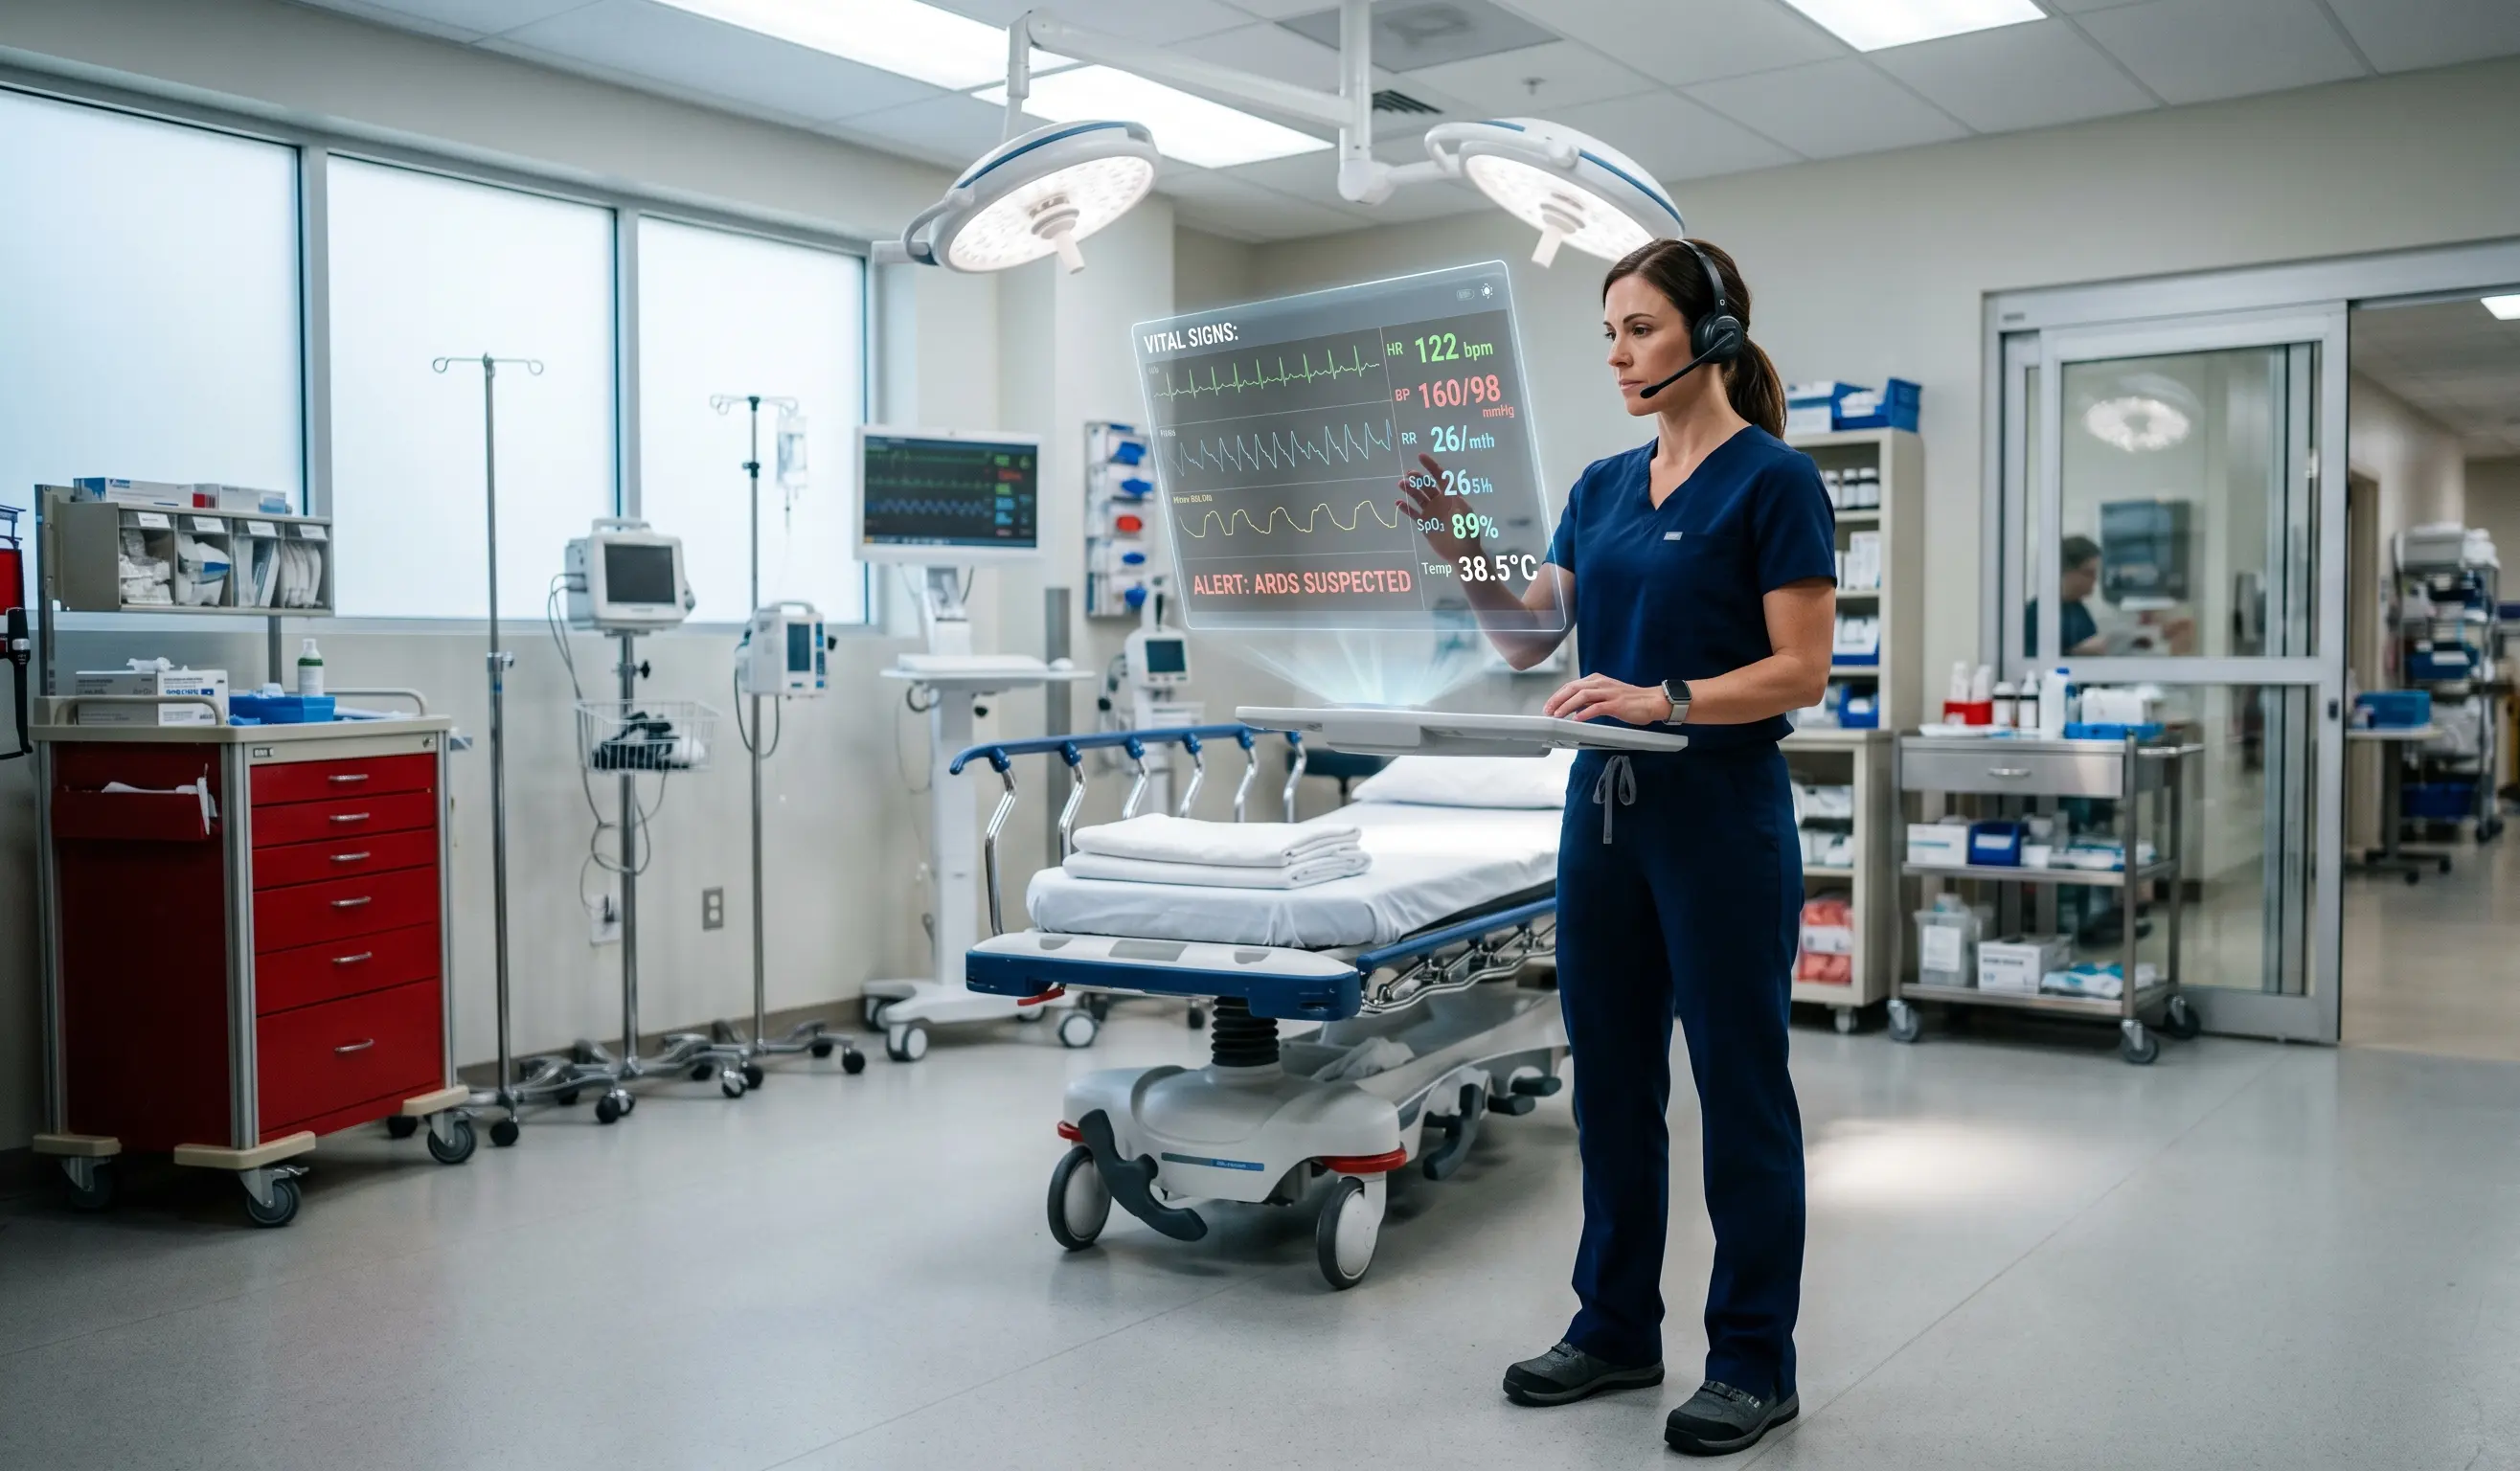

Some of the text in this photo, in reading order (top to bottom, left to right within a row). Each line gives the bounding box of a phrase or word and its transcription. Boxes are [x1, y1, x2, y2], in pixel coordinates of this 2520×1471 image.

[1144, 323, 1238, 353] VITAL SIGNS:
[1386, 332, 1493, 363] HR 122 bpm
[1395, 374, 1501, 409] BP 160/98
[1483, 404, 1514, 419] mmHg
[1401, 432, 1417, 445] RR
[1452, 512, 1499, 539] 89%
[1421, 554, 1538, 582] Temp 38.5°C
[1194, 570, 1412, 595] ALERT: ARDS SUSPECTED
